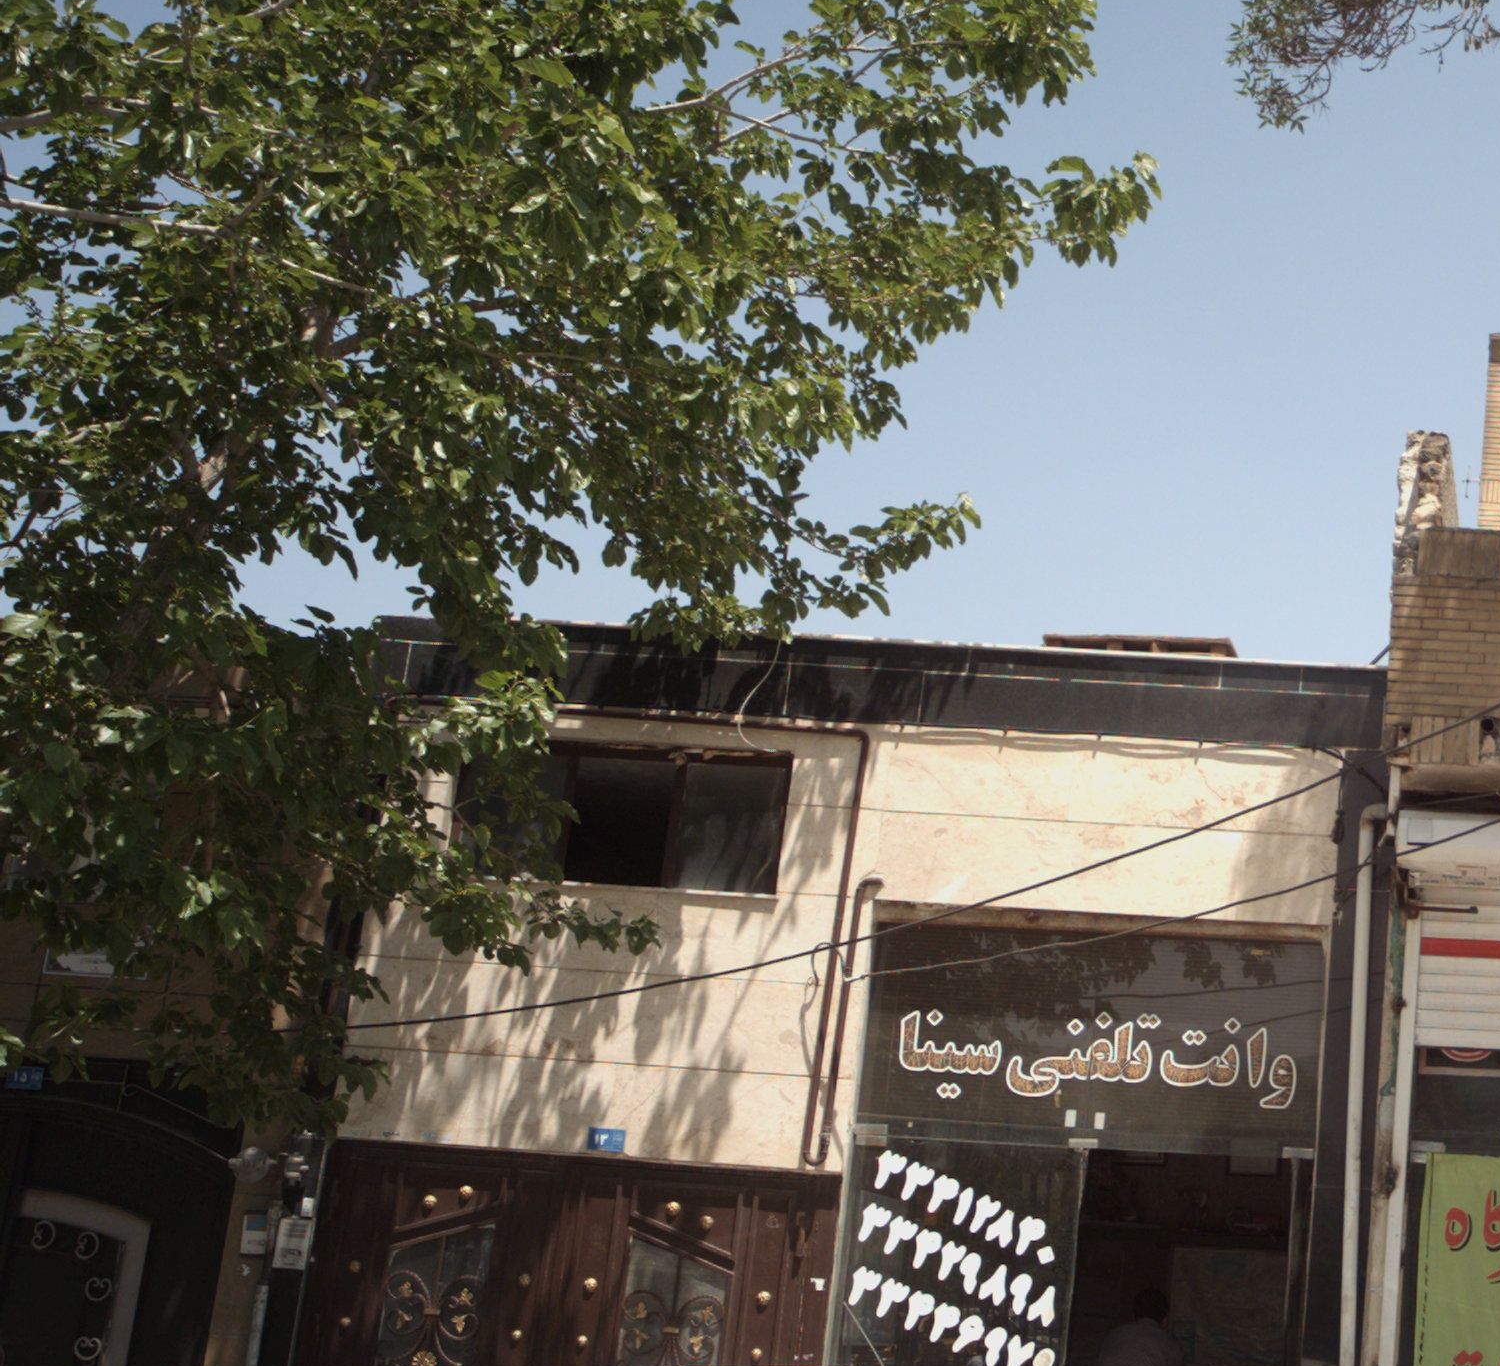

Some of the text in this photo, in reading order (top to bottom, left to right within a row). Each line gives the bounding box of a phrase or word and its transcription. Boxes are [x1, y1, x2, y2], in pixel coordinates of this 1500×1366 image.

[899, 1008, 1298, 1110] وانت تلفنی سینا
